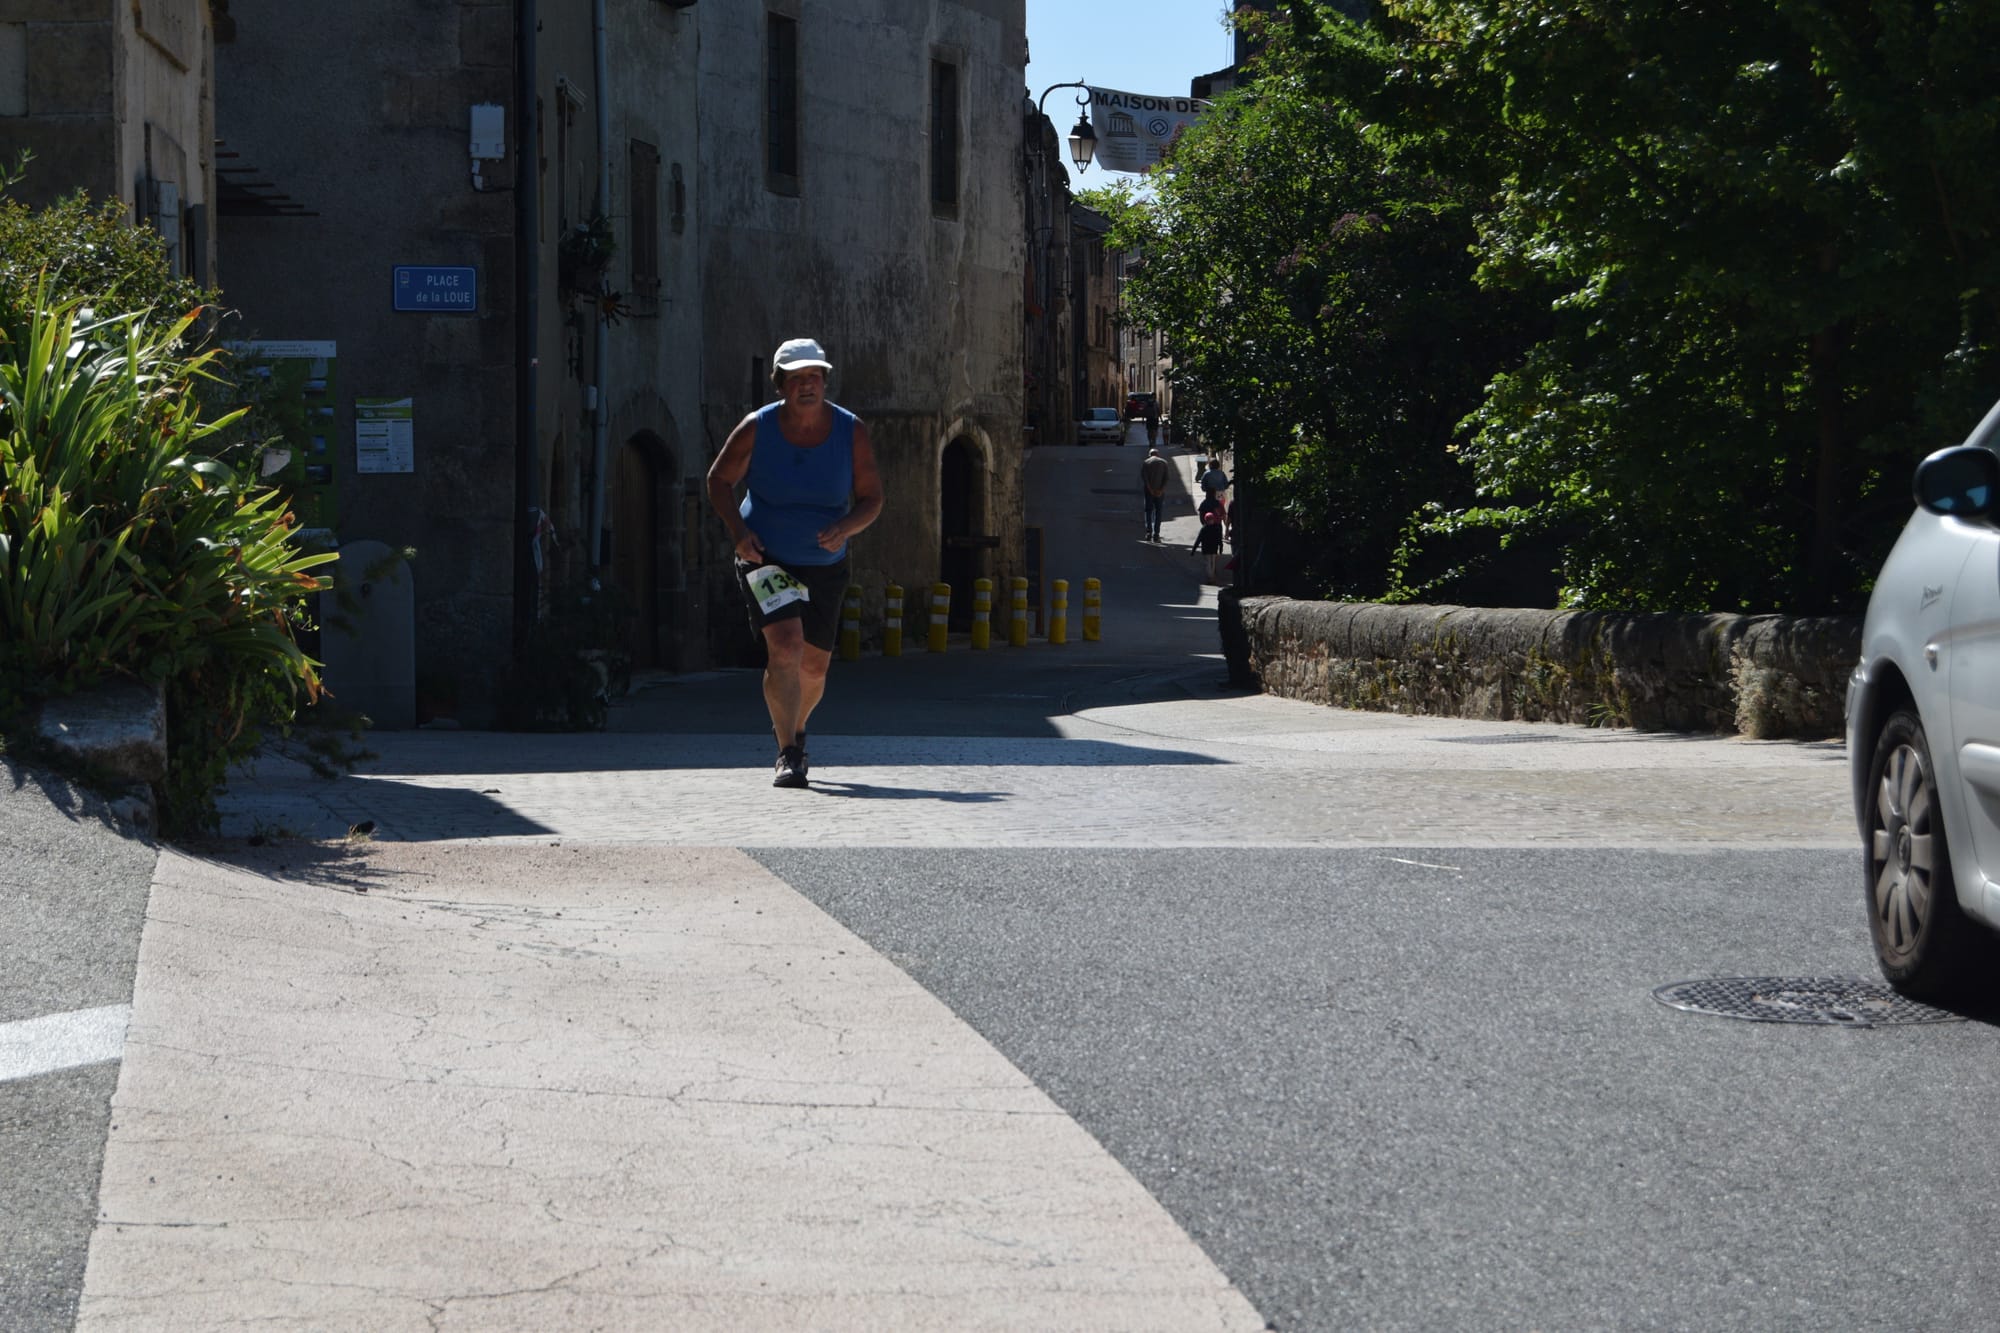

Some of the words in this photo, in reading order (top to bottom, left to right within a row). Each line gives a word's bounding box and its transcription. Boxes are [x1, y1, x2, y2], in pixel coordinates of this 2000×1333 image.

[1094, 92, 1170, 111] MAISON
[1176, 99, 1200, 113] DE
[426, 274, 460, 287] PLACE
[416, 291, 428, 303] de
[431, 291, 441, 303] la
[444, 291, 471, 303] LOUE
